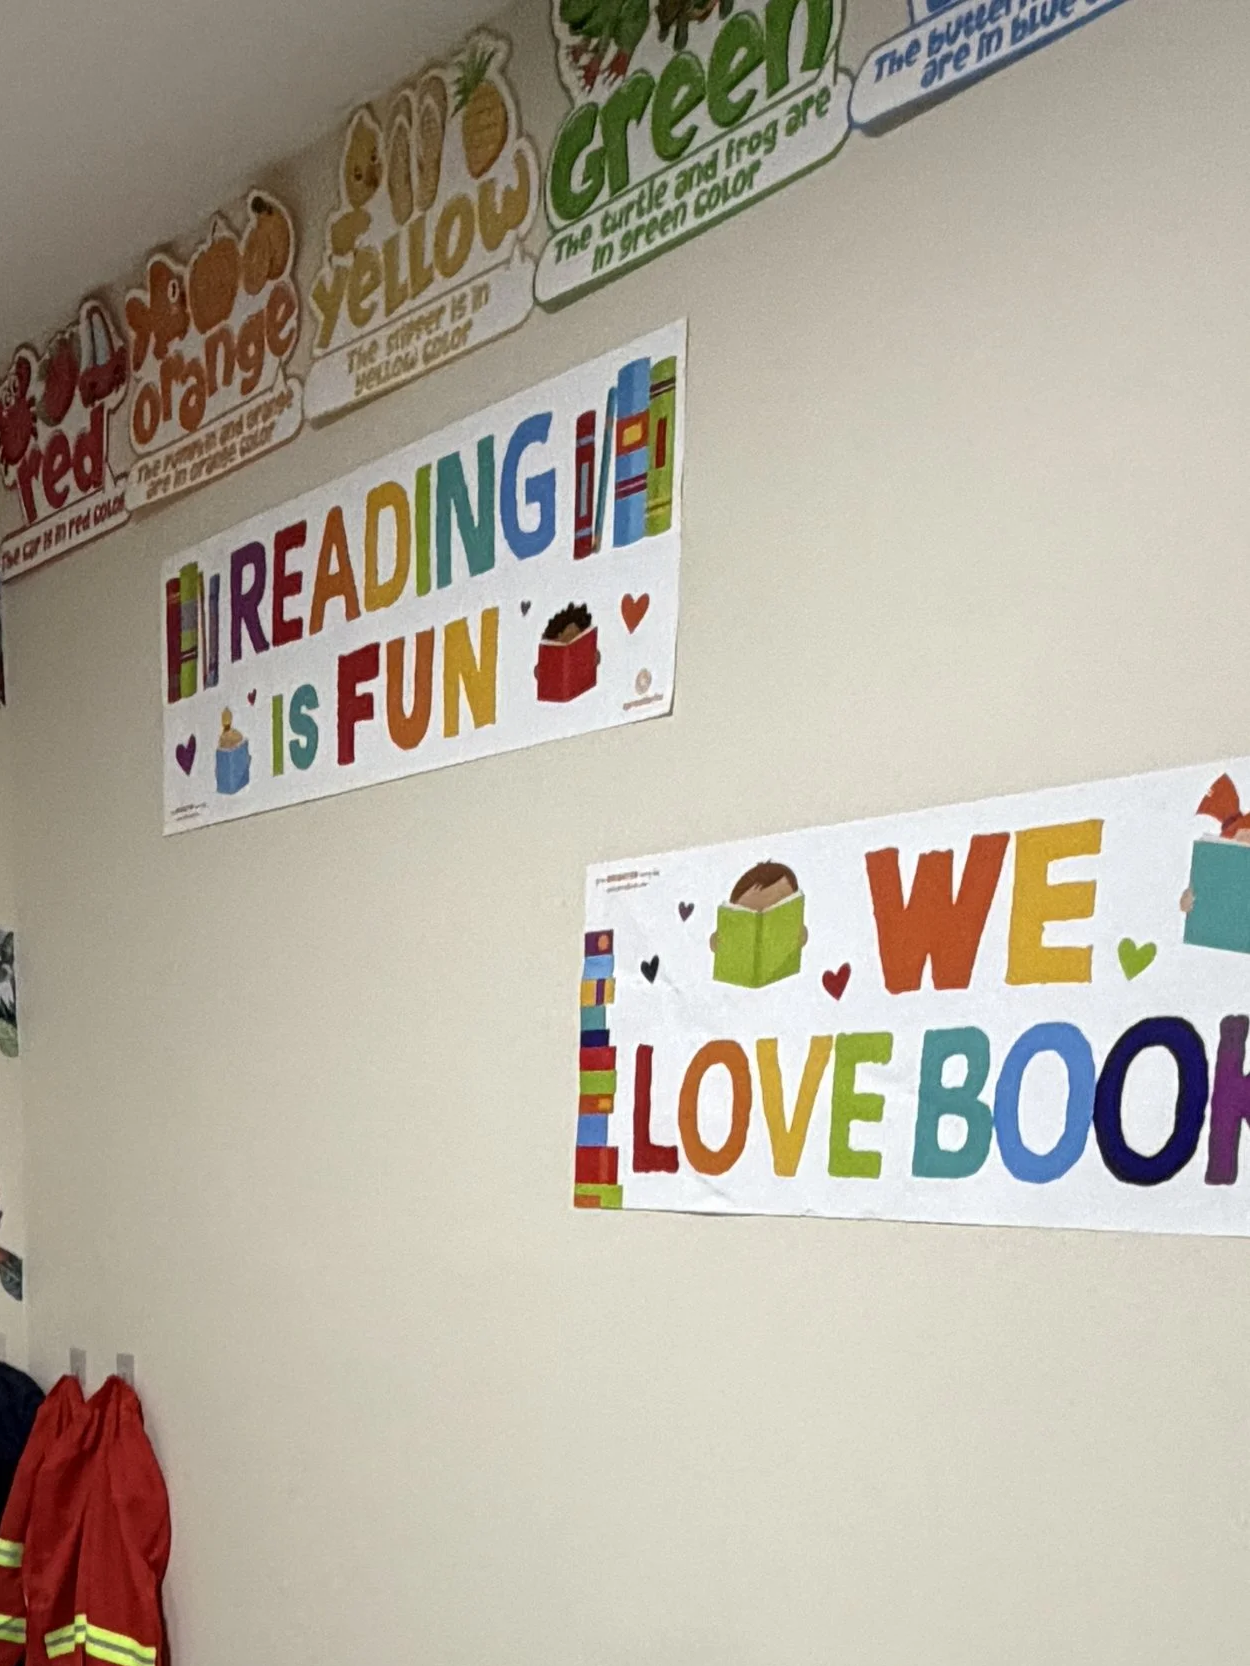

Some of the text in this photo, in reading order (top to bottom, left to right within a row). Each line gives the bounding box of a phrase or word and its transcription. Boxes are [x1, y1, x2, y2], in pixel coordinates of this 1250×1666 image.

[874, 39, 921, 83] The
[921, 43, 970, 88] are
[555, 86, 831, 264] The turtle and frog are
[619, 202, 688, 260] green
[694, 160, 762, 217] color
[133, 280, 298, 445] orange
[348, 340, 379, 374] The
[17, 402, 105, 525] red
[231, 411, 556, 664] READING
[271, 606, 500, 777] IS FUN
[865, 818, 1104, 996] WE
[632, 1031, 894, 1179] LOVE
